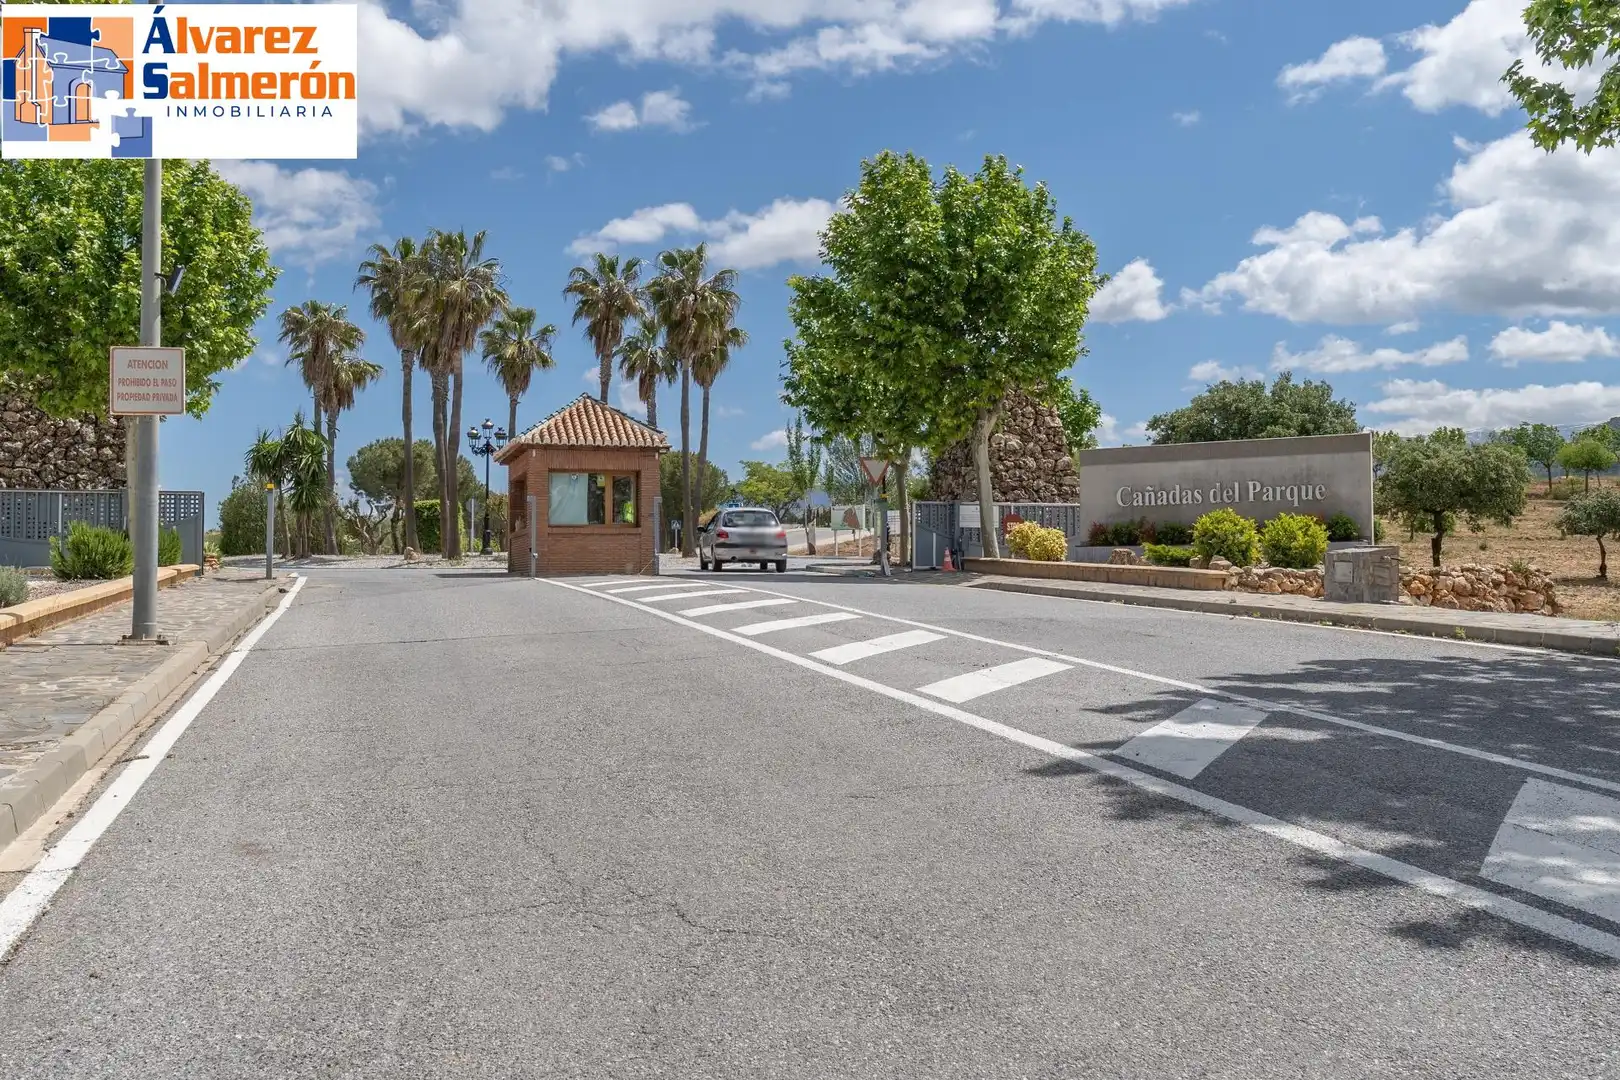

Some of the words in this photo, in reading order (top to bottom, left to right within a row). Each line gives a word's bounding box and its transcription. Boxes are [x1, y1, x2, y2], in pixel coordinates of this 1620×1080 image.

[127, 359, 168, 369] ATENCION
[117, 378, 151, 387] PROHIBIDO
[152, 378, 159, 387] EL
[160, 378, 177, 387] PASO
[116, 392, 151, 401] PROPIEDAD
[152, 392, 178, 401] PRIVADA
[1116, 484, 1203, 507] Cañadas
[1209, 482, 1240, 504] del
[1248, 481, 1327, 507] Parque
